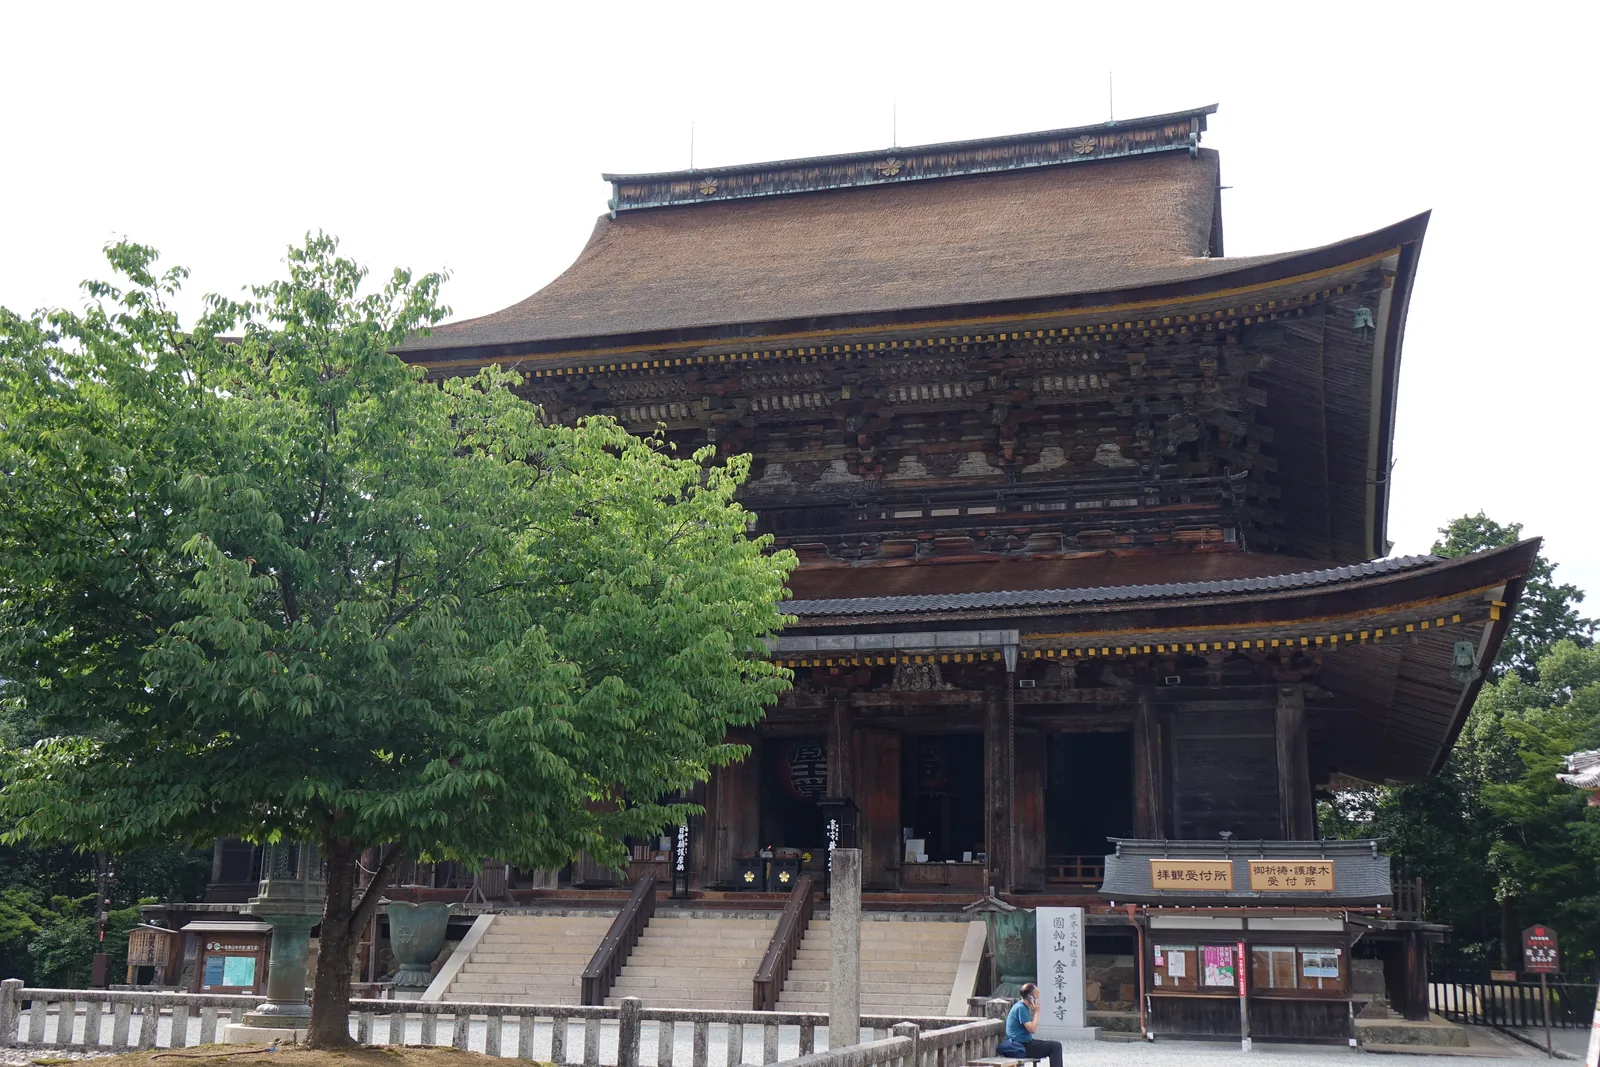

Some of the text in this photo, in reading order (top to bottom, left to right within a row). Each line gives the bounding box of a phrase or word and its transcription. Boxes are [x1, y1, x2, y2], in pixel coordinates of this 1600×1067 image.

[1157, 869, 1227, 882] 拝観受付所
[1267, 877, 1317, 887] 受付所
